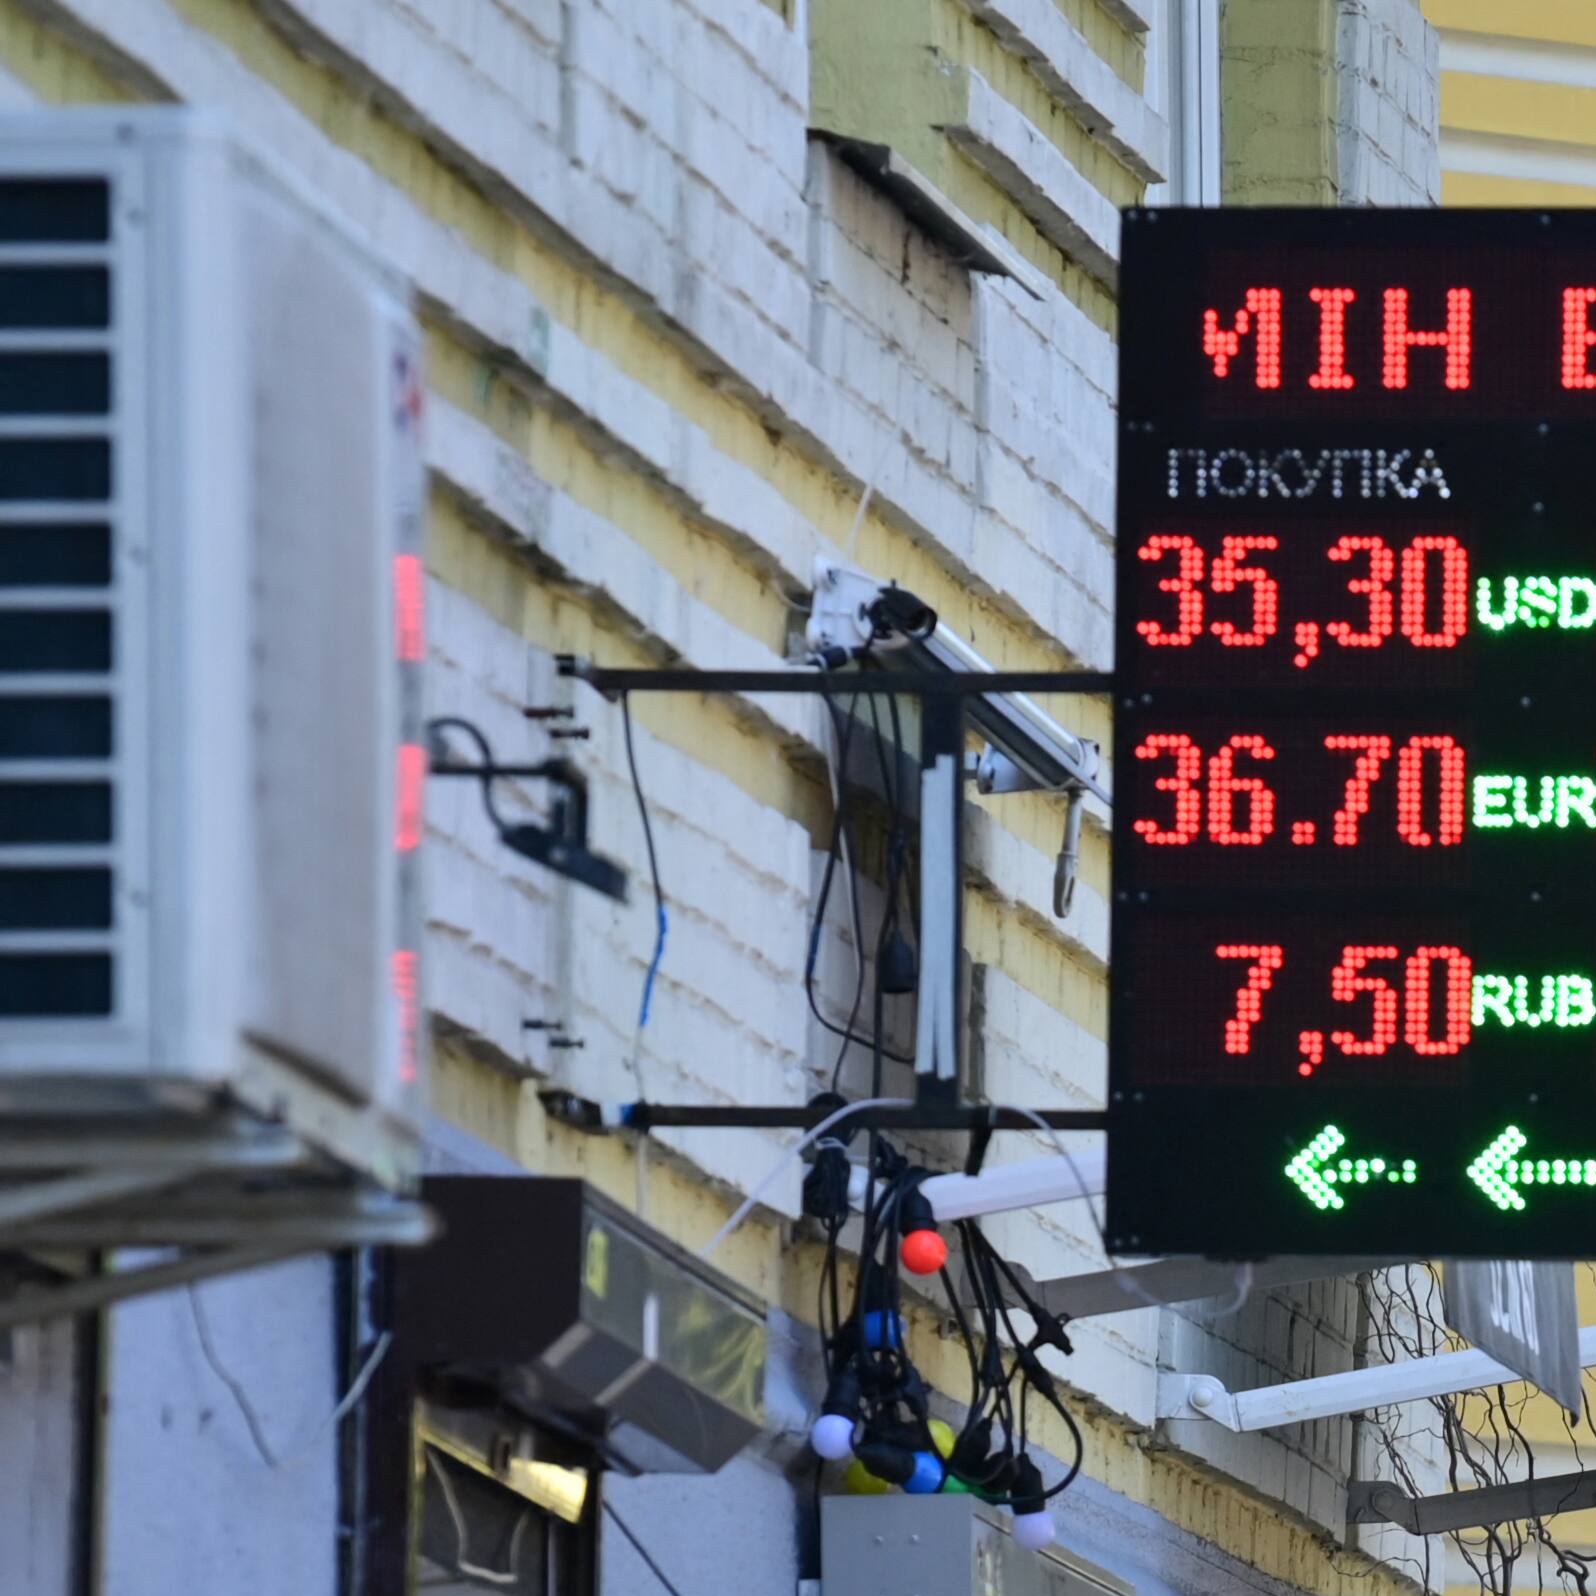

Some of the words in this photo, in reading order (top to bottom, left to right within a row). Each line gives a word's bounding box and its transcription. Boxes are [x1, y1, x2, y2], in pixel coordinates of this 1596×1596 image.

[1167, 448, 1451, 499] ПОКУПКА
[1136, 534, 1469, 669] 35,30
[1215, 944, 1473, 1077] 7,50
